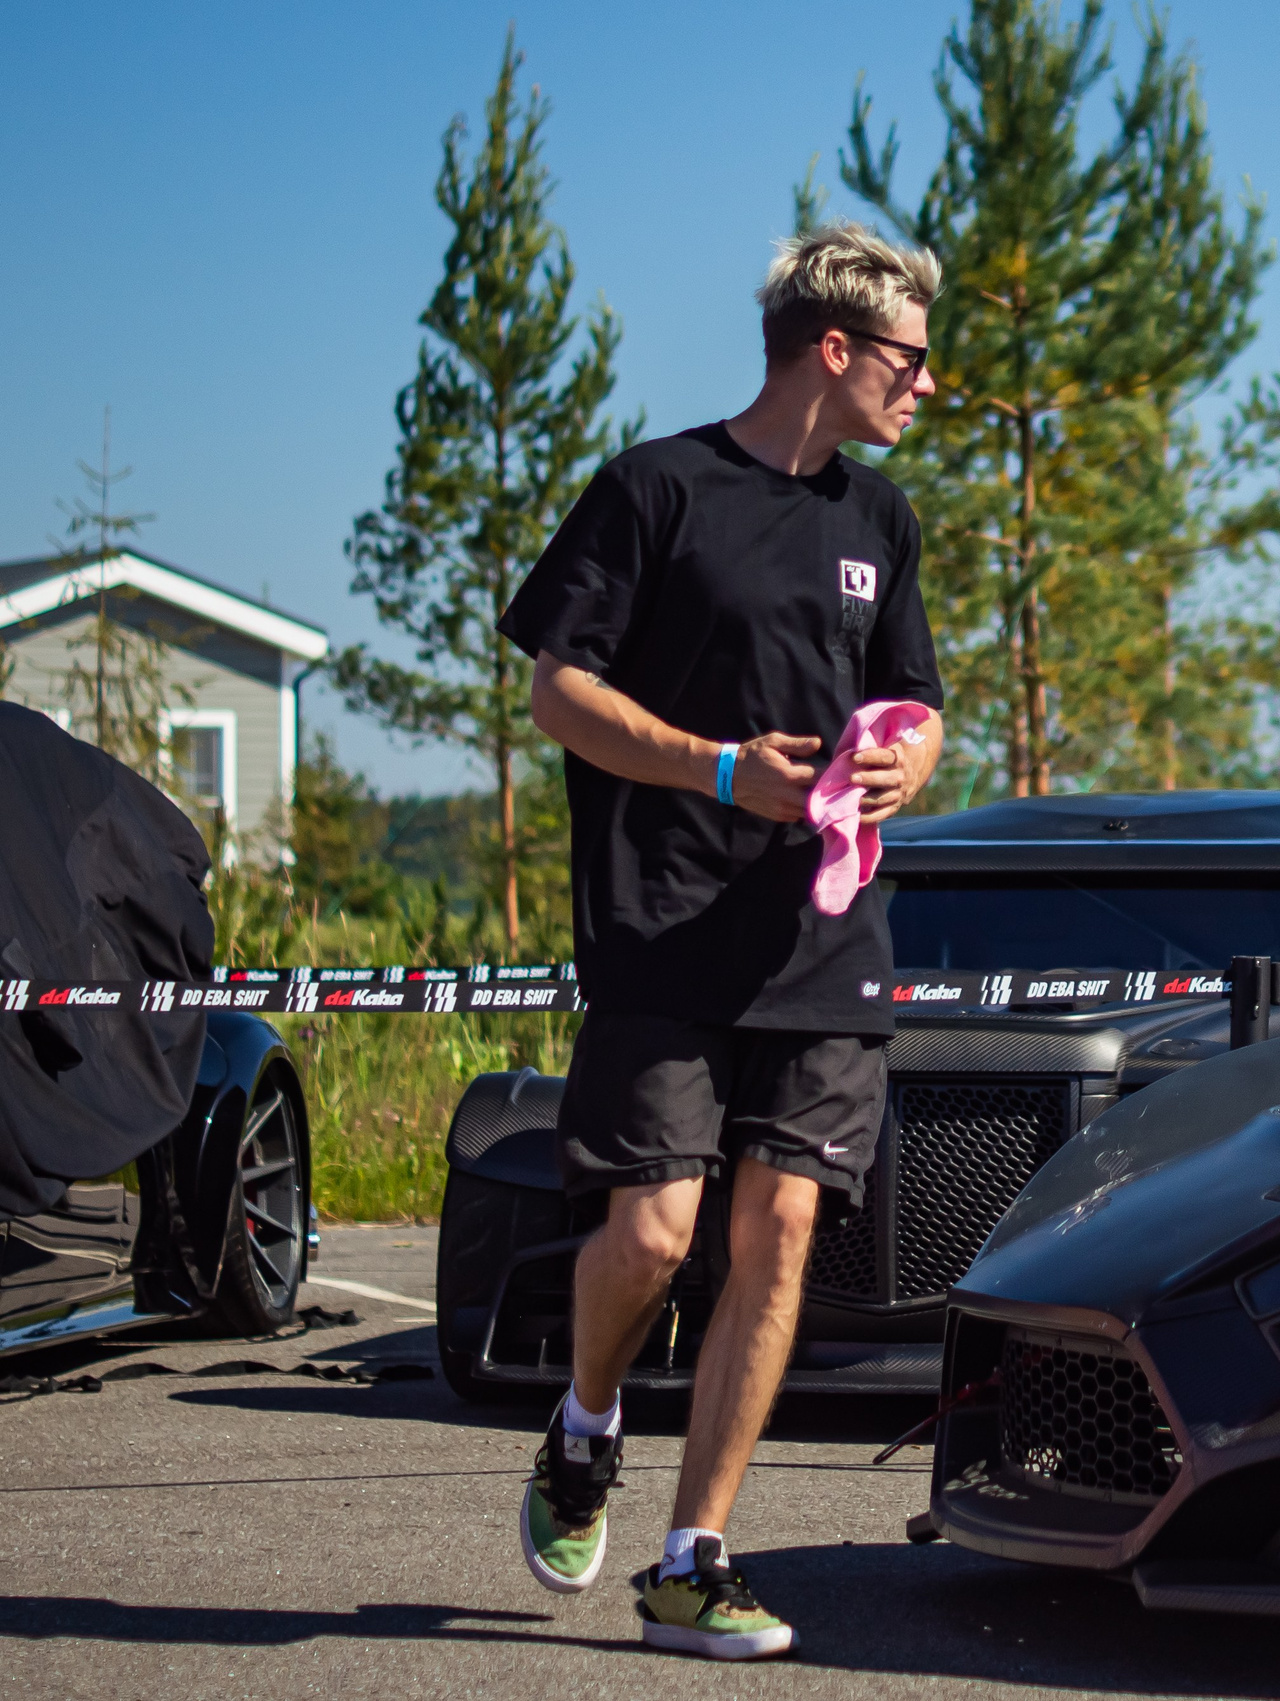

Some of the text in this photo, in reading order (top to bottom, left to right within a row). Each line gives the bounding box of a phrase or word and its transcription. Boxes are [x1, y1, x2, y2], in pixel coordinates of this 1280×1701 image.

[38, 987, 121, 1005] ddKaba
[180, 989, 270, 1006] DD EBA SHIT
[324, 988, 404, 1006] ddKaba
[470, 989, 558, 1006] DD EBA SHIT
[1027, 980, 1110, 998] DD EBA SHIT
